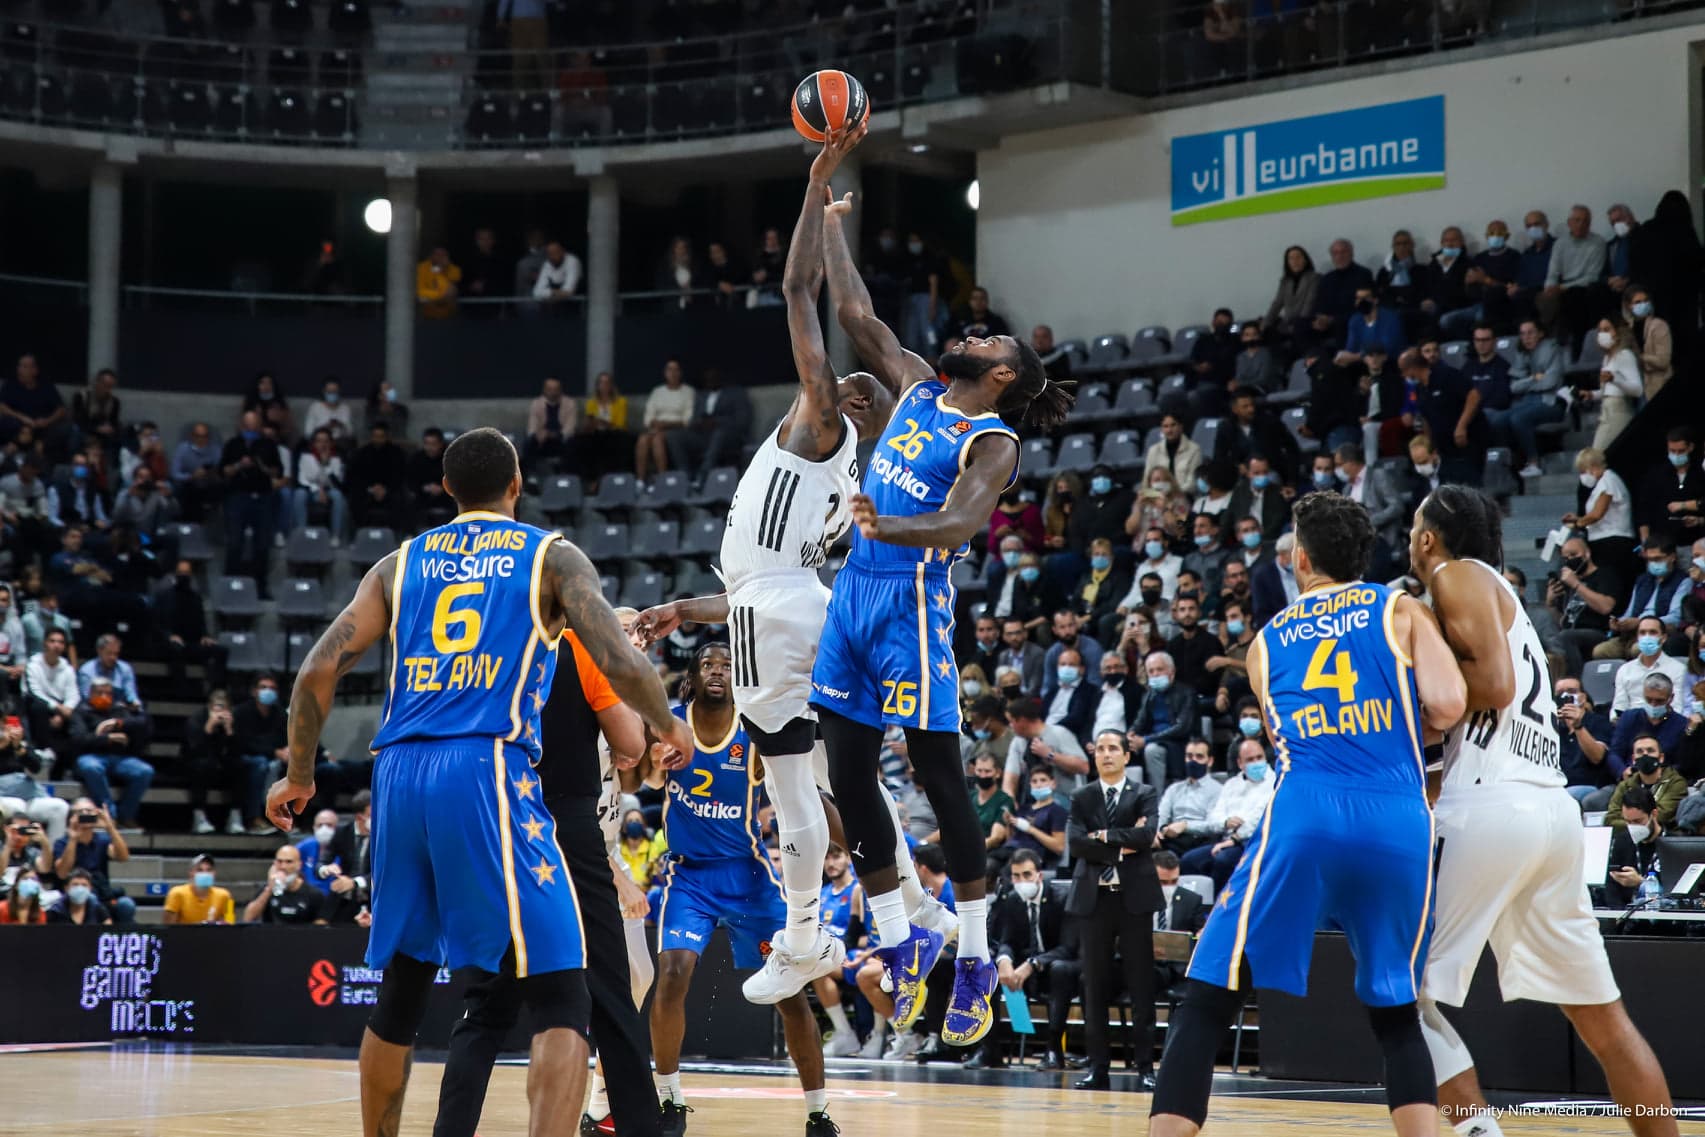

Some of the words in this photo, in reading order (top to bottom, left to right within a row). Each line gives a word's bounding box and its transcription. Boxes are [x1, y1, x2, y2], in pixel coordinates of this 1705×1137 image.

[1191, 131, 1419, 199] villeurbanne
[886, 418, 934, 461] 26
[423, 529, 528, 556] WILLIAMS
[431, 582, 485, 654] 6
[1272, 588, 1377, 629] CALOIARO
[404, 657, 442, 692] TEL
[1302, 639, 1359, 703] 4
[822, 685, 850, 700] Rapyd
[882, 680, 918, 717] 26
[1292, 703, 1338, 739] TEL
[1339, 699, 1392, 736] AVIV
[690, 769, 714, 797] 2
[80, 965, 152, 1009] game
